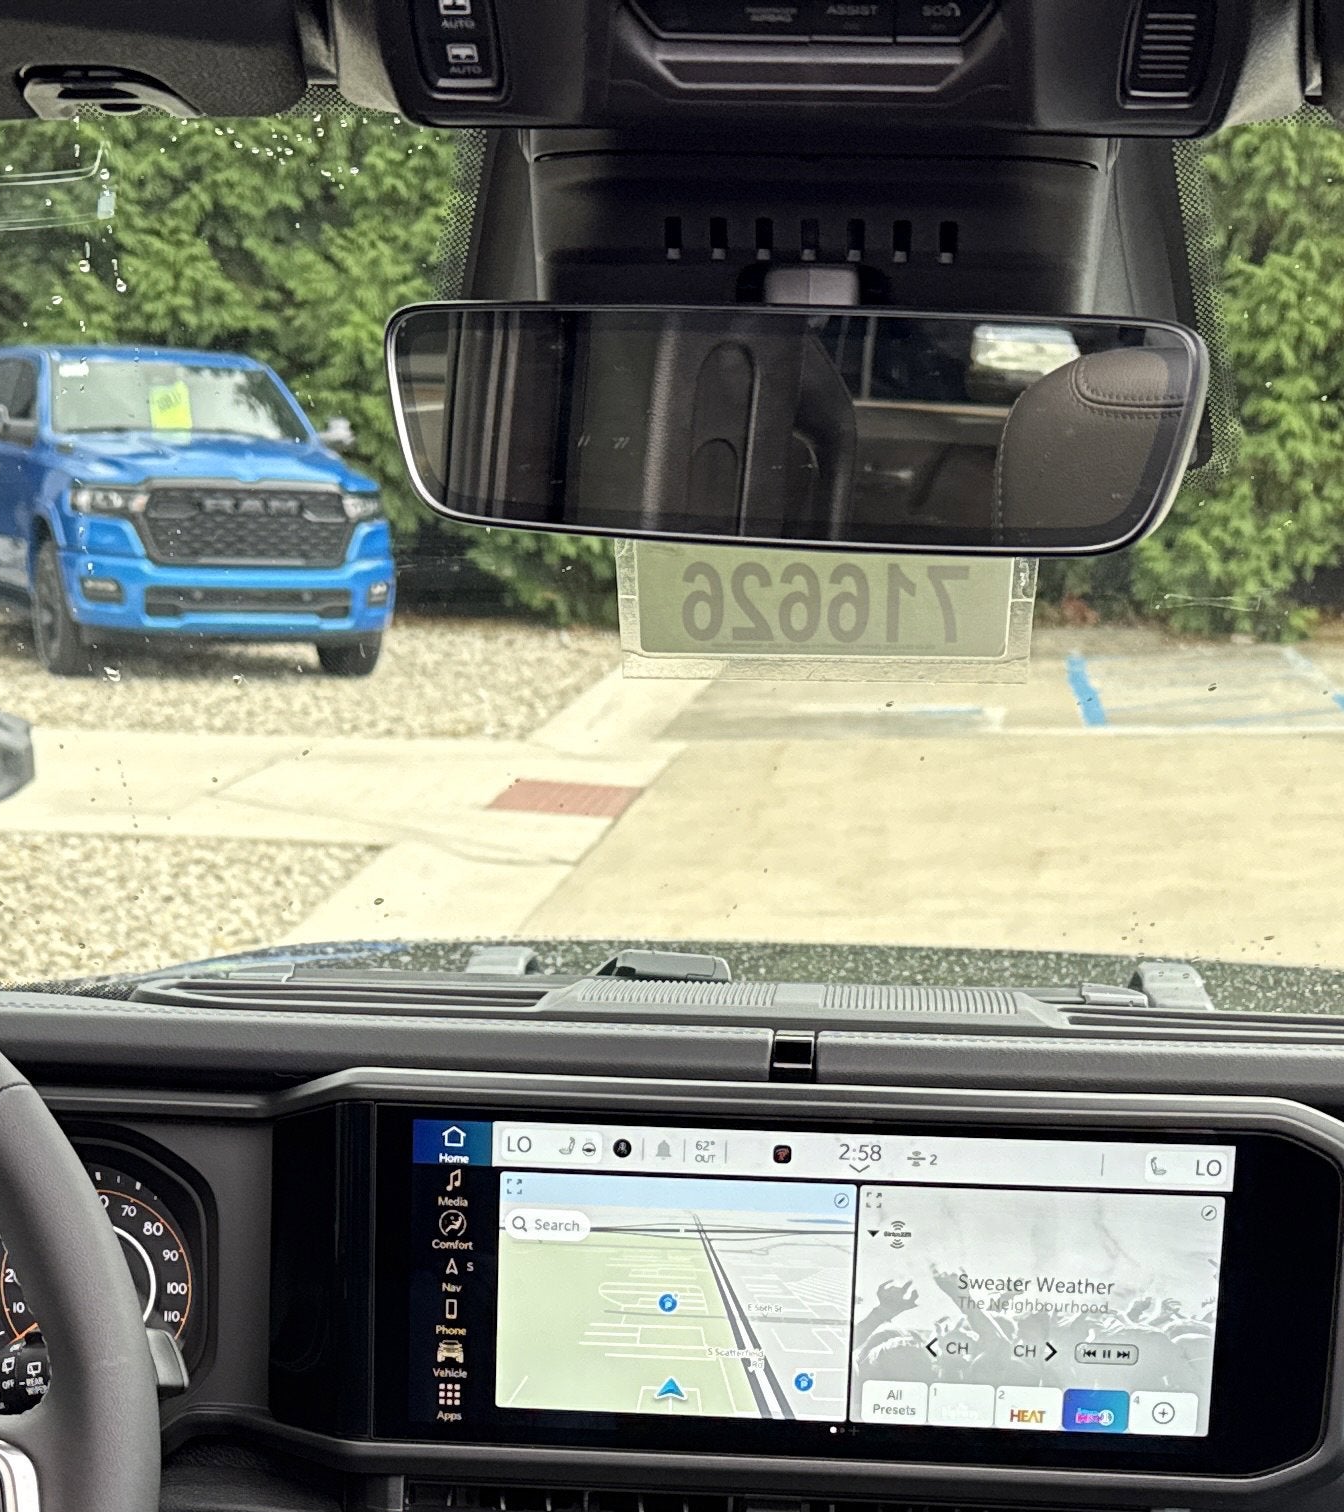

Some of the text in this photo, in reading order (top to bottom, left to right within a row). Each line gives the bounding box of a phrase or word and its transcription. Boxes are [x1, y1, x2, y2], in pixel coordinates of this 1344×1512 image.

[200, 497, 300, 516] RAM
[506, 1135, 533, 1154] LO
[695, 1139, 716, 1152] 62°
[439, 1153, 469, 1165] Home
[694, 1153, 716, 1164] OUT
[838, 1143, 882, 1162] 2:58
[928, 1154, 938, 1167] 2
[1195, 1159, 1223, 1177] LO
[437, 1196, 468, 1207] Media
[121, 1205, 137, 1217] 70
[143, 1221, 164, 1237] 80
[534, 1218, 580, 1233] Search
[432, 1238, 474, 1251] Comfort
[162, 1250, 179, 1262] 90
[166, 1282, 188, 1295] 100
[441, 1281, 463, 1294] Nav
[957, 1273, 1115, 1297] Sweater Weather
[12, 1301, 26, 1314] 10
[958, 1296, 1110, 1316] The Neighbourhood
[163, 1310, 181, 1323] 110
[435, 1323, 467, 1337] Phone
[946, 1342, 969, 1356] CH
[1013, 1344, 1037, 1358] CH
[432, 1366, 468, 1379] Vehicle
[1, 1379, 15, 1390] OFF
[886, 1389, 903, 1401] All
[998, 1390, 1006, 1401] 2
[436, 1409, 463, 1423] Apps
[872, 1404, 917, 1417] Presets
[1010, 1408, 1047, 1424] HEAT
